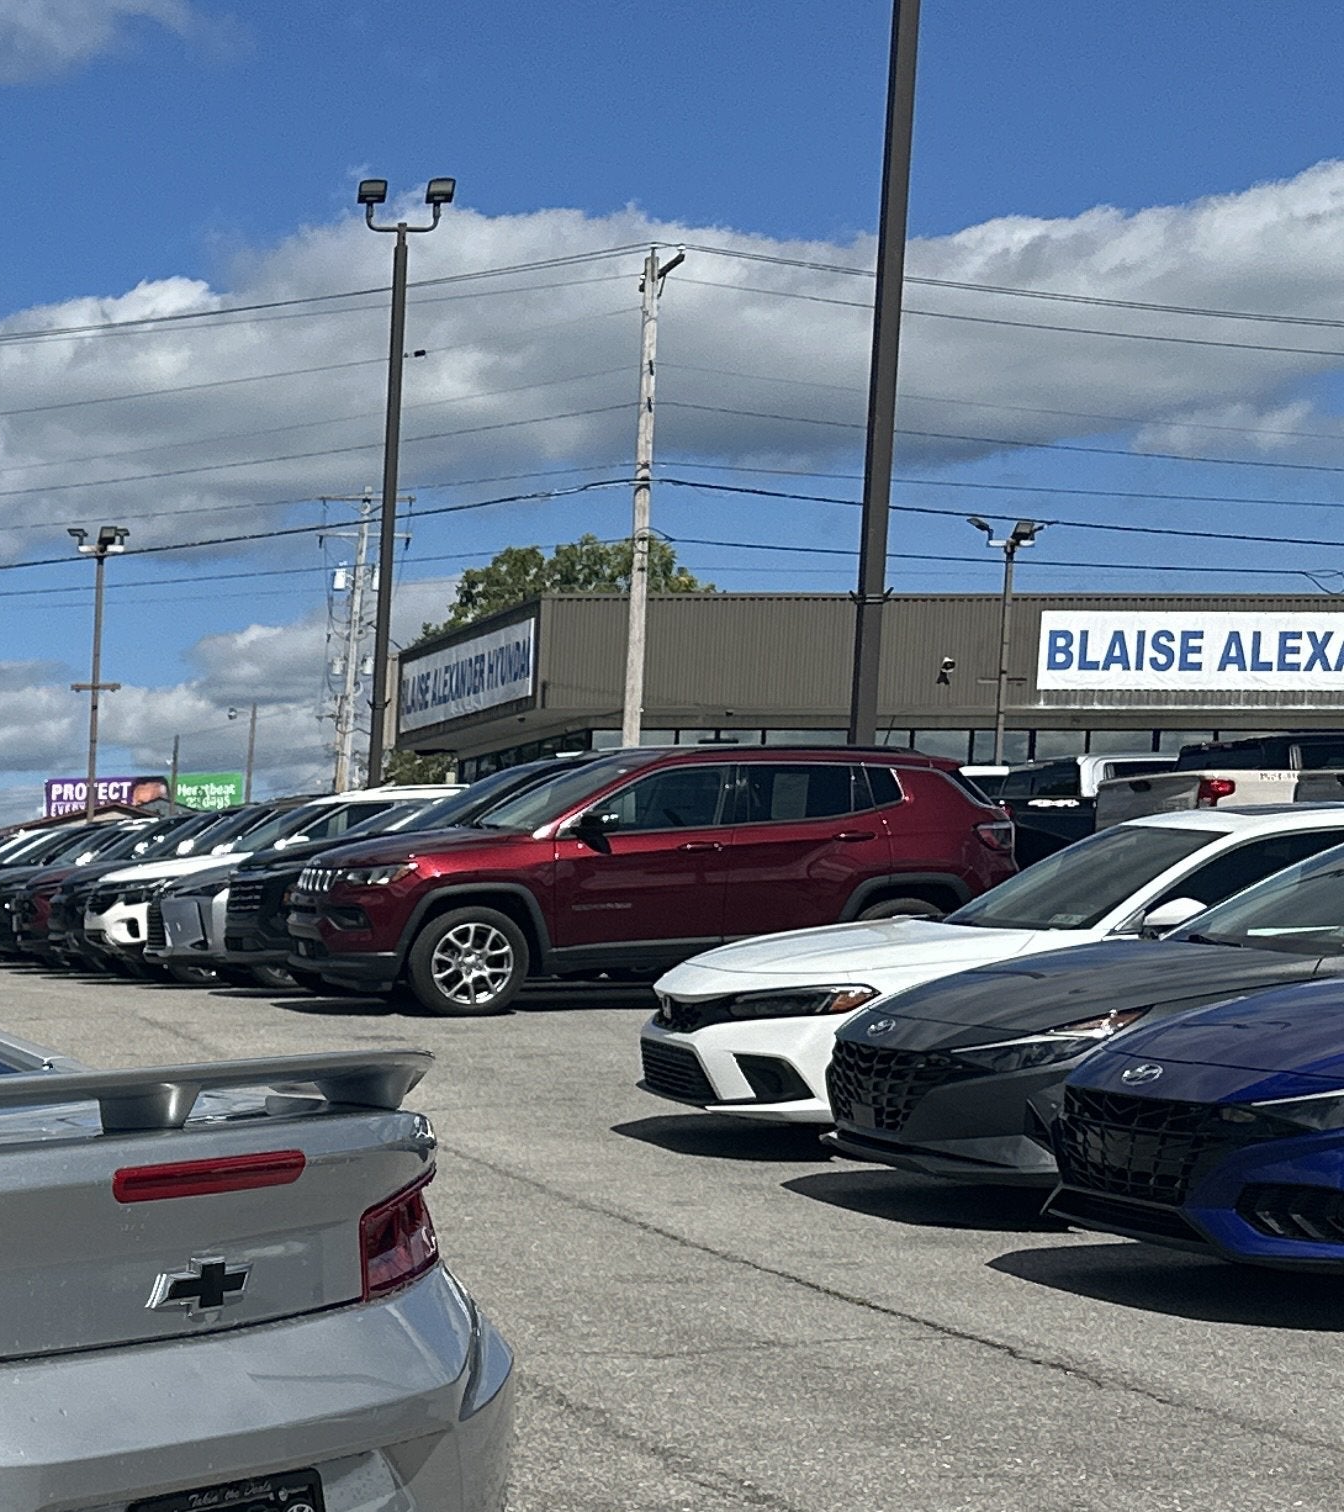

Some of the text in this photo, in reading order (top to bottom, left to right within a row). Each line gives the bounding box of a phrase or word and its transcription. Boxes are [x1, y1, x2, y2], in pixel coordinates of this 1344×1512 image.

[1047, 630, 1204, 671] BLAISE
[431, 654, 485, 707] ALEXANDER
[51, 782, 132, 801] PROECT
